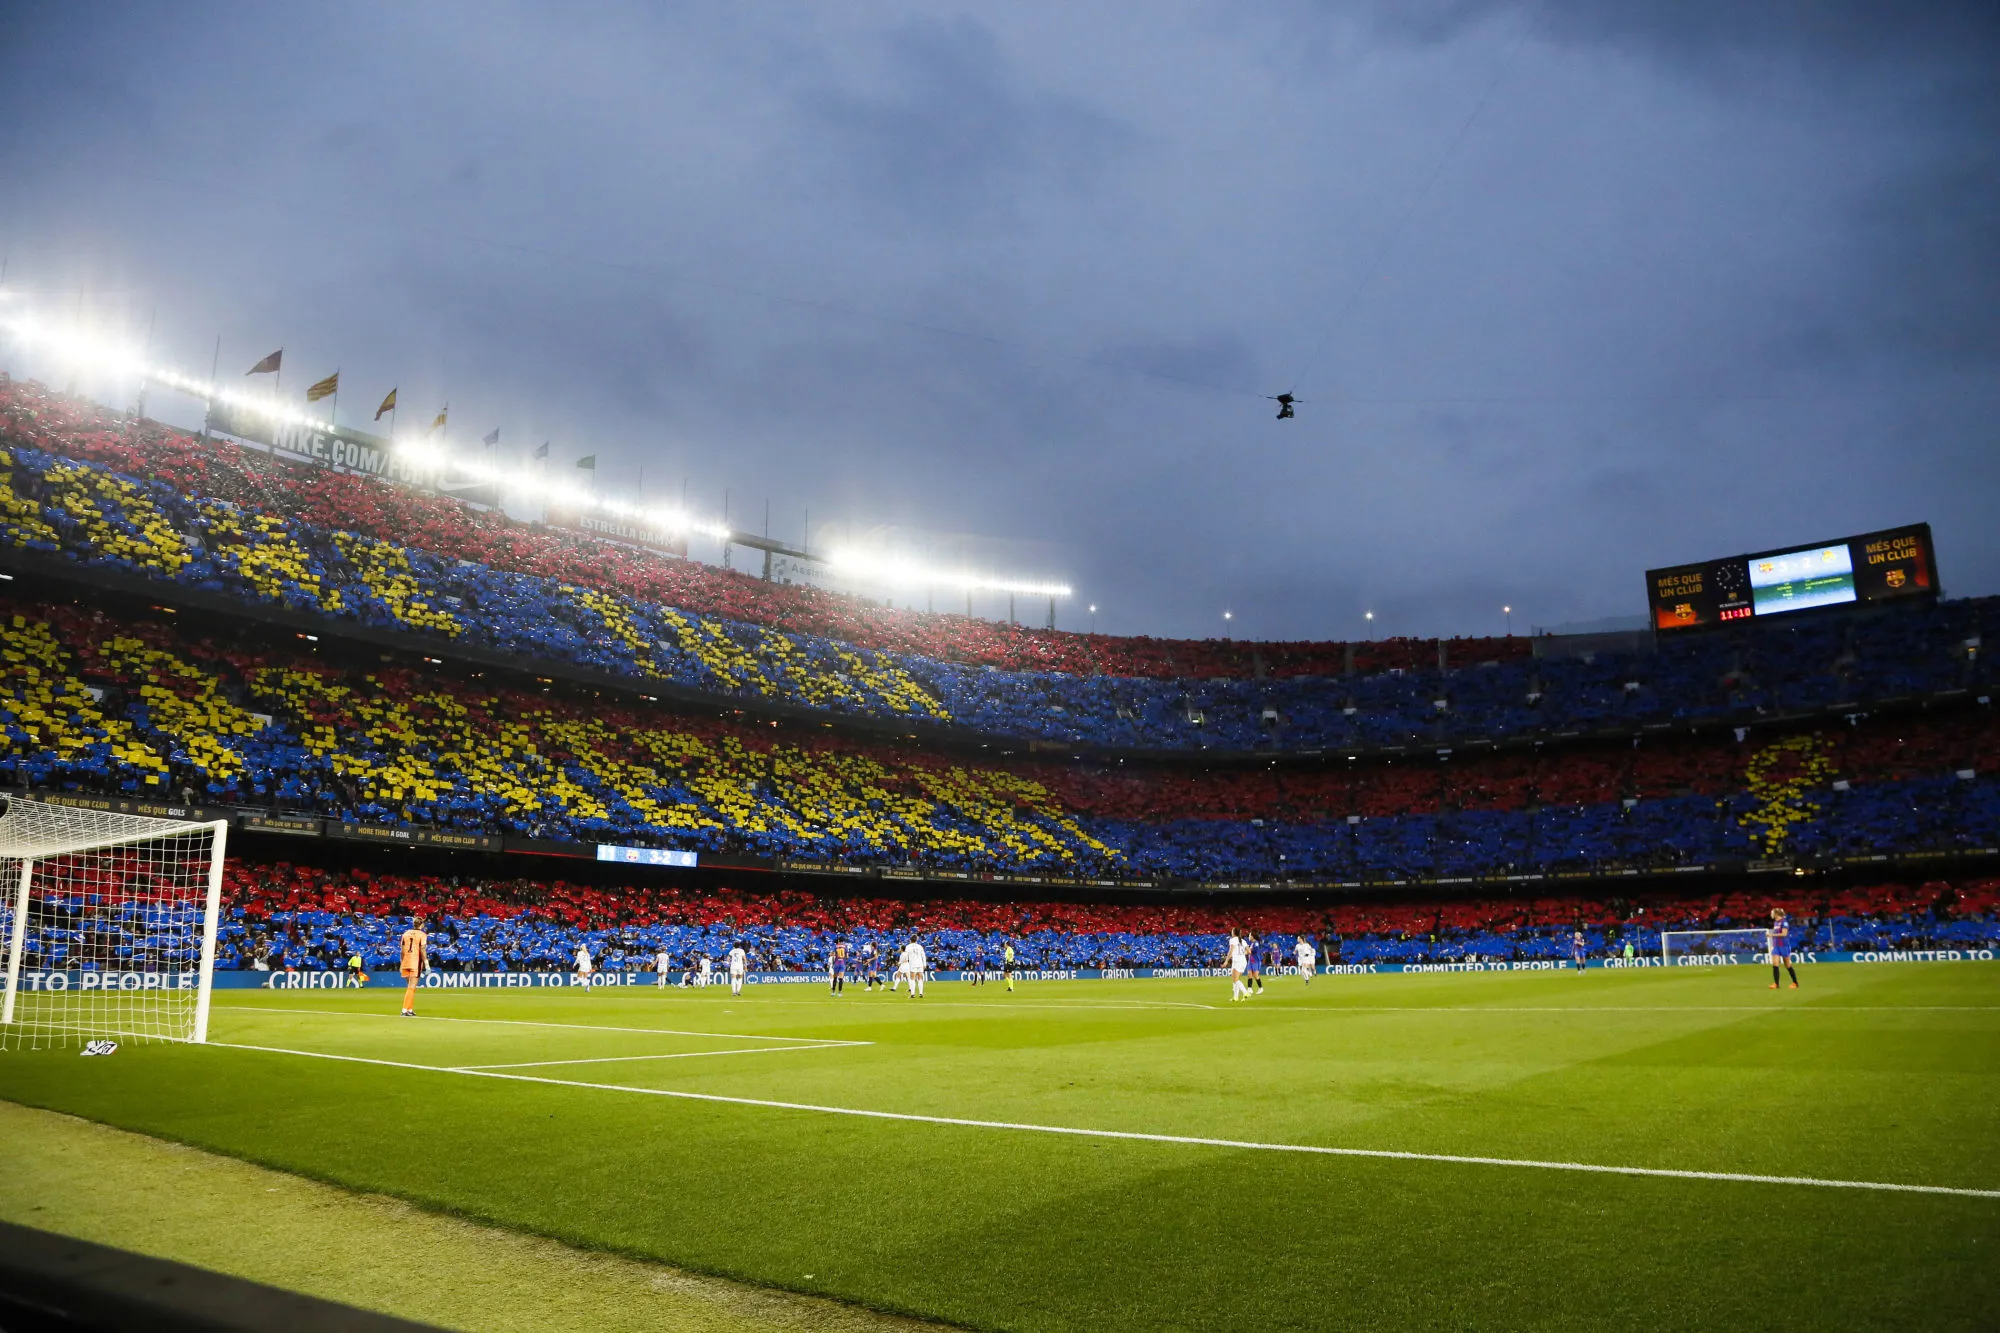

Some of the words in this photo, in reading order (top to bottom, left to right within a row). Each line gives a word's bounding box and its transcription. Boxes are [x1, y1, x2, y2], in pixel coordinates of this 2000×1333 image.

[581, 515, 636, 539] ESTRELLA
[1865, 540, 1890, 553] MÉS
[1892, 536, 1916, 549] QUE
[1868, 553, 1885, 565] UN
[1887, 548, 1917, 561] CLUB
[1658, 575, 1680, 587] MÉS
[1682, 573, 1703, 585] QUE
[1660, 587, 1674, 598] UN
[1676, 584, 1703, 596] CLUB
[1720, 607, 1751, 620] 11:10
[62, 798, 78, 806] QUE
[79, 799, 90, 807] UN
[91, 801, 110, 809] CLUB
[138, 804, 152, 814] MÉS
[153, 806, 167, 815] QUE
[168, 808, 185, 816] GOLS
[358, 827, 374, 835] MORE
[375, 828, 389, 836] THAN
[408, 937, 413, 953] 1
[1678, 953, 1737, 966] GRIFOLS
[1853, 950, 1961, 964] COMMITTED
[1966, 949, 1993, 961] TO
[1101, 968, 1134, 979] GRIFOLS
[1152, 968, 1199, 978] COMMITTED
[1201, 968, 1211, 977] TO
[1213, 968, 1232, 977] PEOP
[1325, 964, 1377, 974] GRIFOLS
[1403, 963, 1484, 974] COMMITTED
[1488, 962, 1507, 972] TO
[1513, 960, 1567, 970] PEOPLE
[27, 972, 68, 991] TO
[83, 972, 192, 991] PEOPLE
[538, 972, 563, 987] TO
[762, 975, 778, 984] UEFA
[779, 975, 809, 984] WOMEN'S
[1024, 971, 1039, 980] TO
[1041, 970, 1077, 980] PEOPLE
